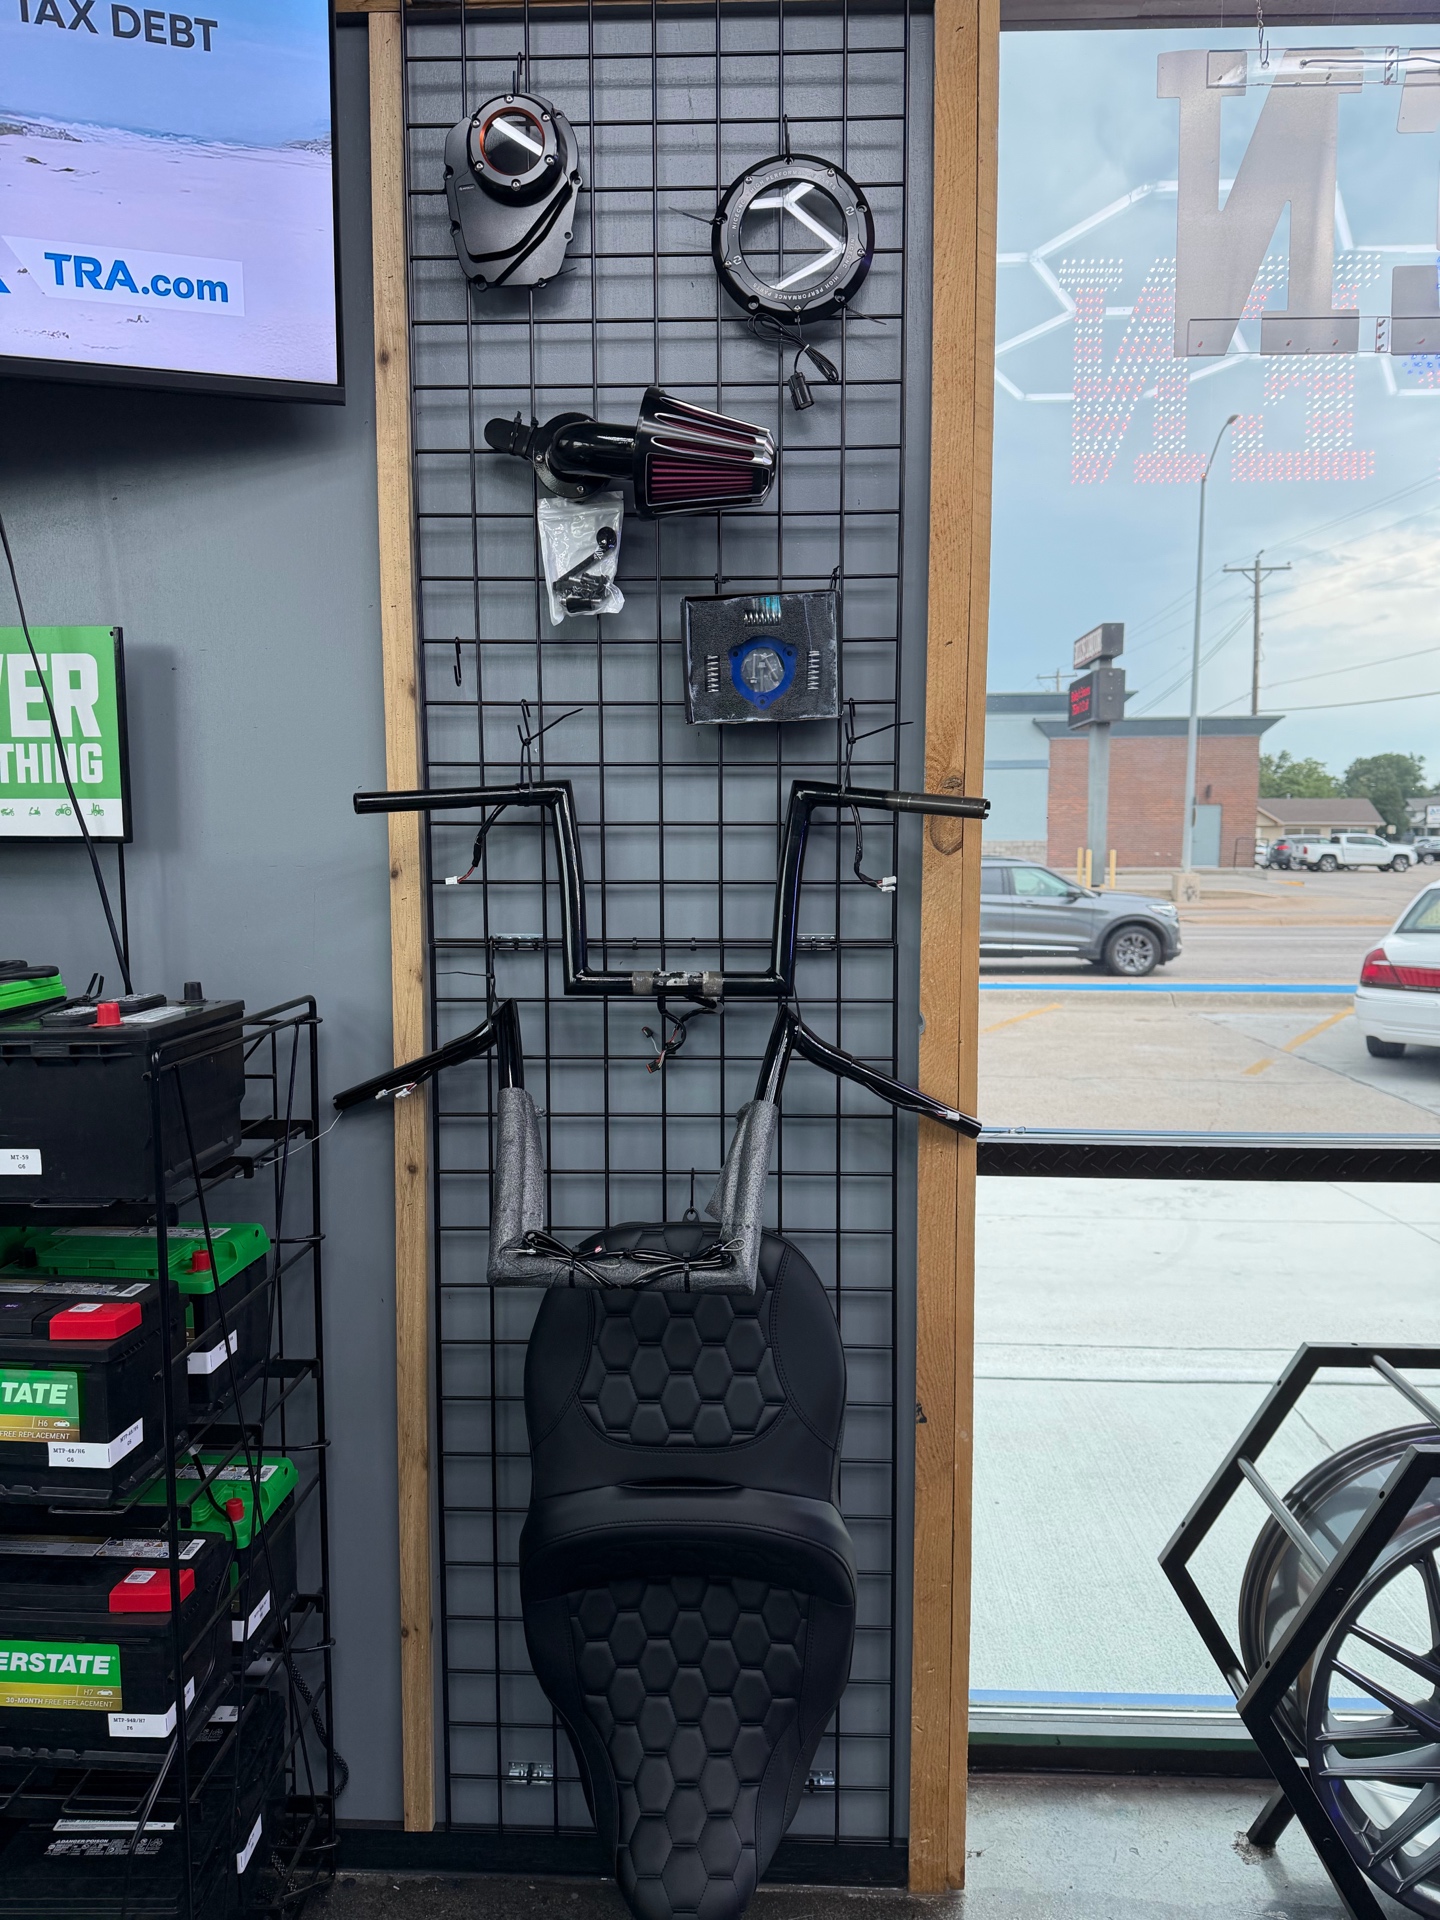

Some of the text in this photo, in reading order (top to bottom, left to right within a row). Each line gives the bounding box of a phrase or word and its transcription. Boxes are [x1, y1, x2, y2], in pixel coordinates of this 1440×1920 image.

[110, 4, 218, 52] DEBT
[732, 200, 746, 230] NICECNC
[750, 180, 765, 193] HIGH
[44, 252, 229, 303] TRA.com
[825, 275, 839, 289] HIGH
[753, 282, 772, 296] PARTS
[774, 288, 824, 300] PERFORMANCE
[0, 1430, 70, 1440] FREE REPLACEMENT
[5, 1696, 43, 1704] 30-MONTH
[63, 1699, 113, 1708] REPLACEMENT
